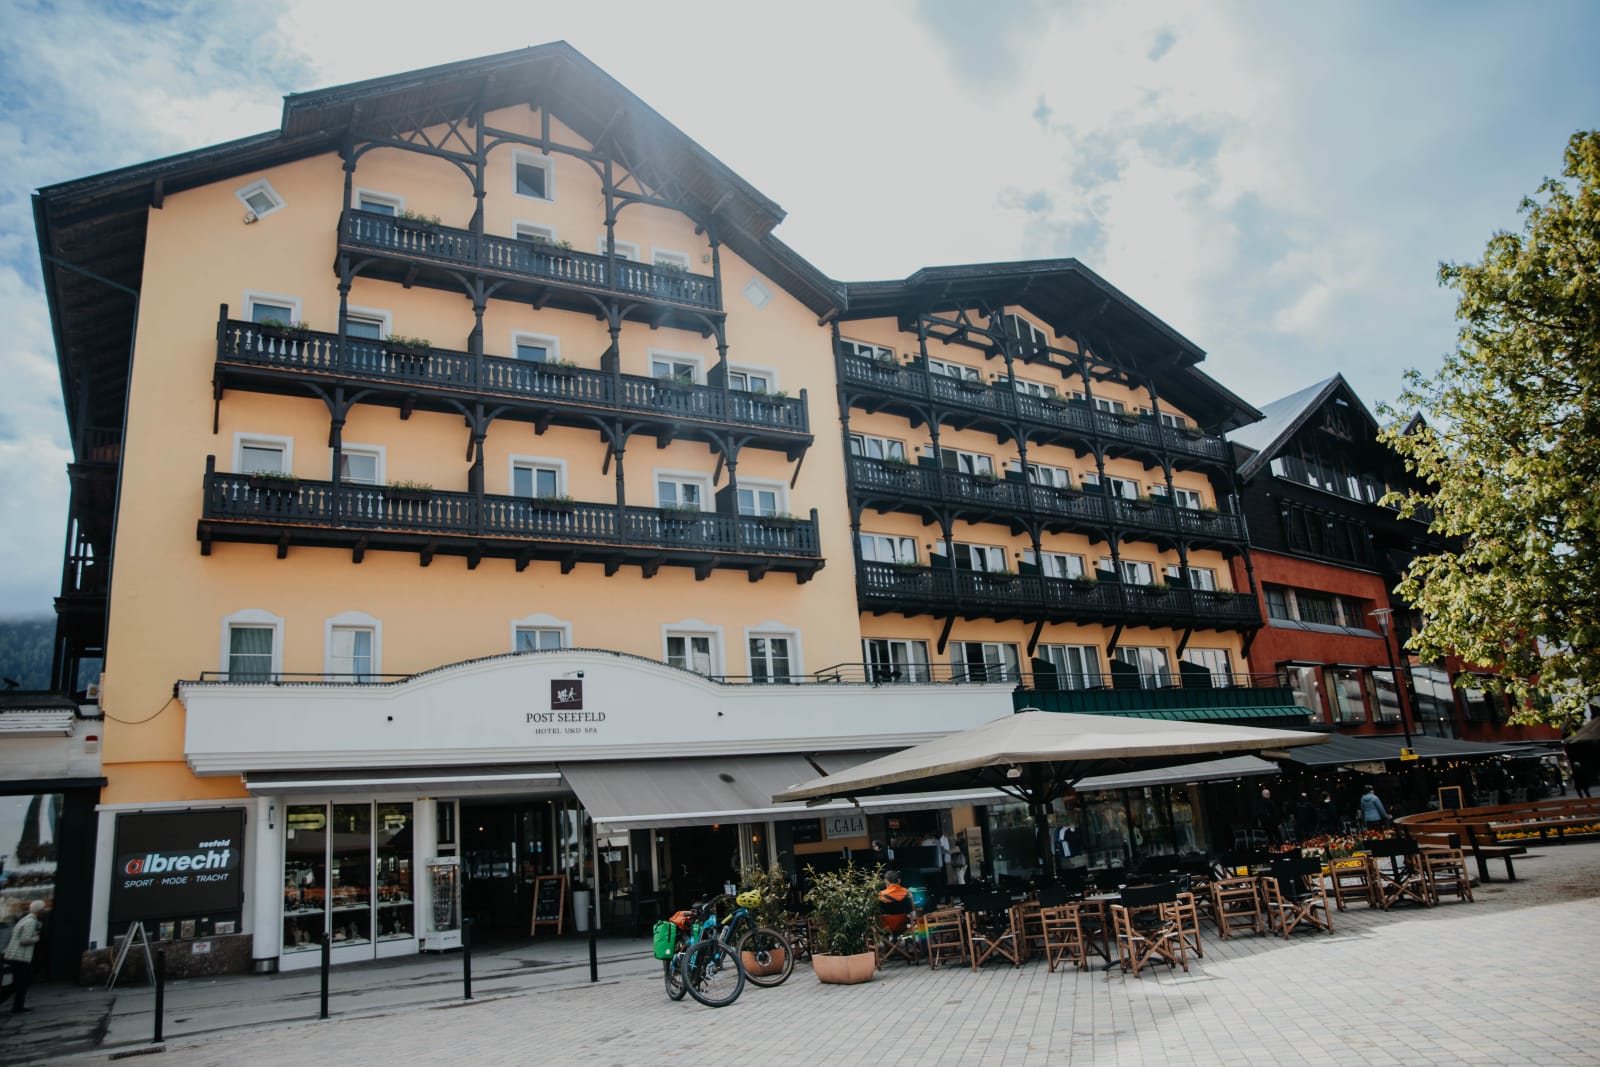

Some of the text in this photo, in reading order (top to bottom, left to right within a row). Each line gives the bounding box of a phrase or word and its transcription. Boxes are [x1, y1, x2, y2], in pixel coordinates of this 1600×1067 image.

[526, 712, 606, 723] POST SEEFELD
[834, 817, 864, 833] CALA
[199, 839, 231, 848] seefeld
[125, 849, 231, 875] albrecht
[124, 873, 230, 888] SPORT MODE TRACHT
